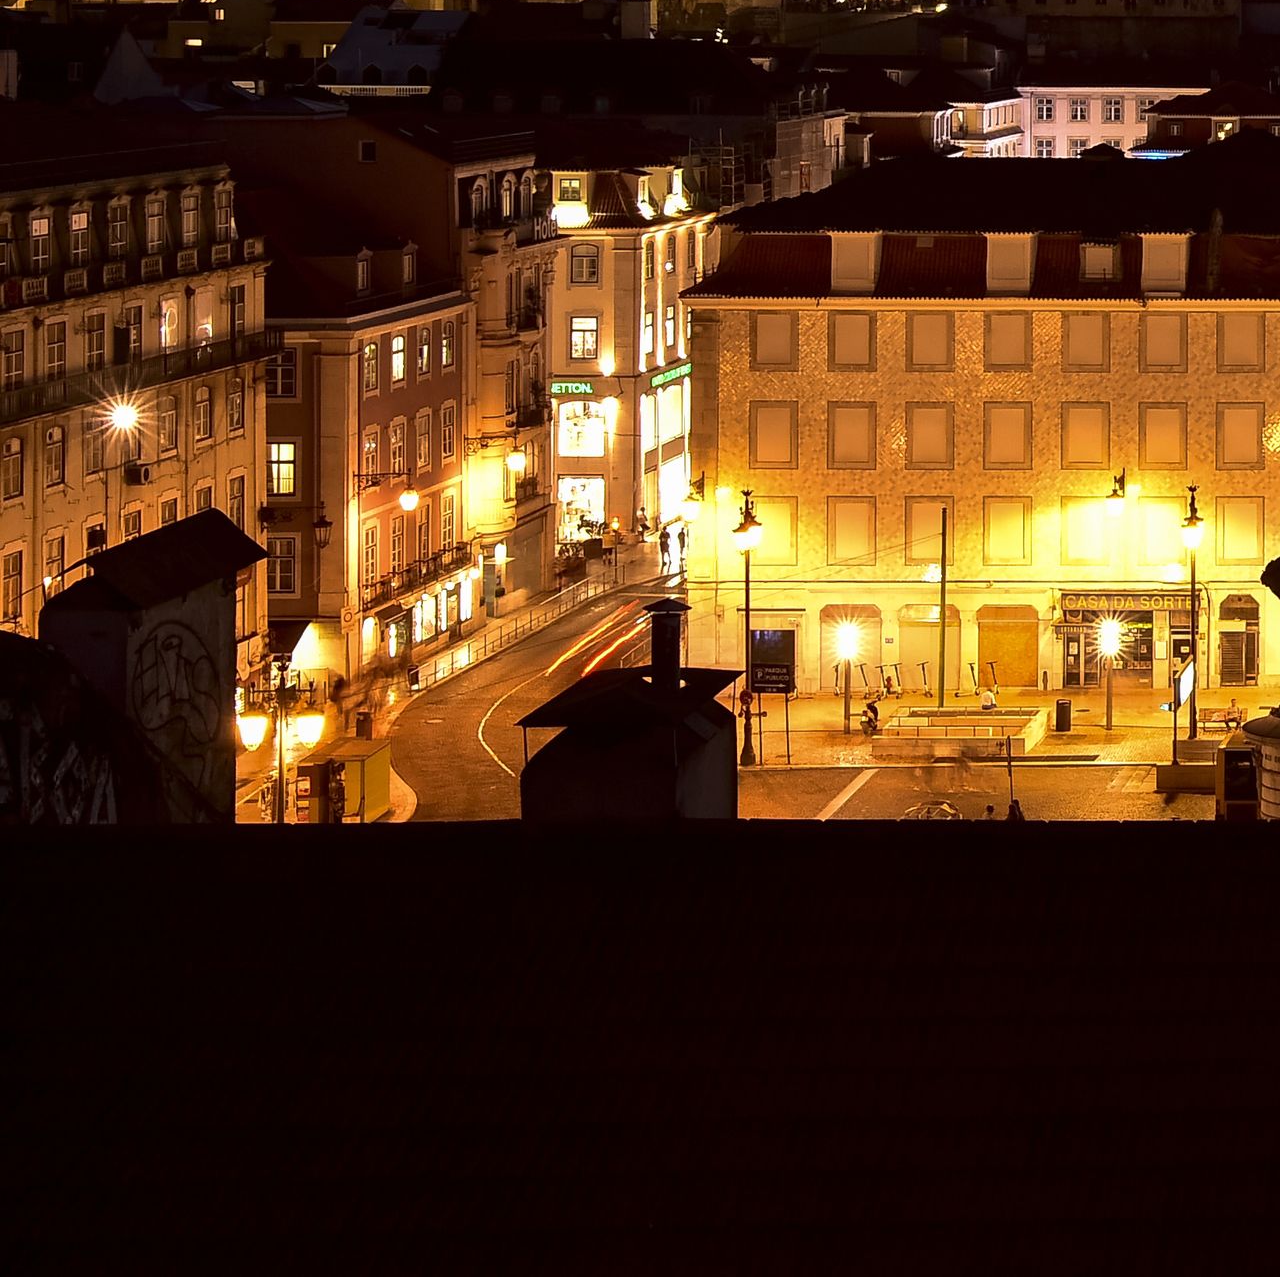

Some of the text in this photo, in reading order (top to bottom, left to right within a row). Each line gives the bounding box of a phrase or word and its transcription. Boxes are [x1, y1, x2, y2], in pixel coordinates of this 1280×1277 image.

[534, 215, 558, 241] Hotel
[551, 383, 595, 395] ETTON.
[1065, 595, 1191, 609] CASA DA SORTE
